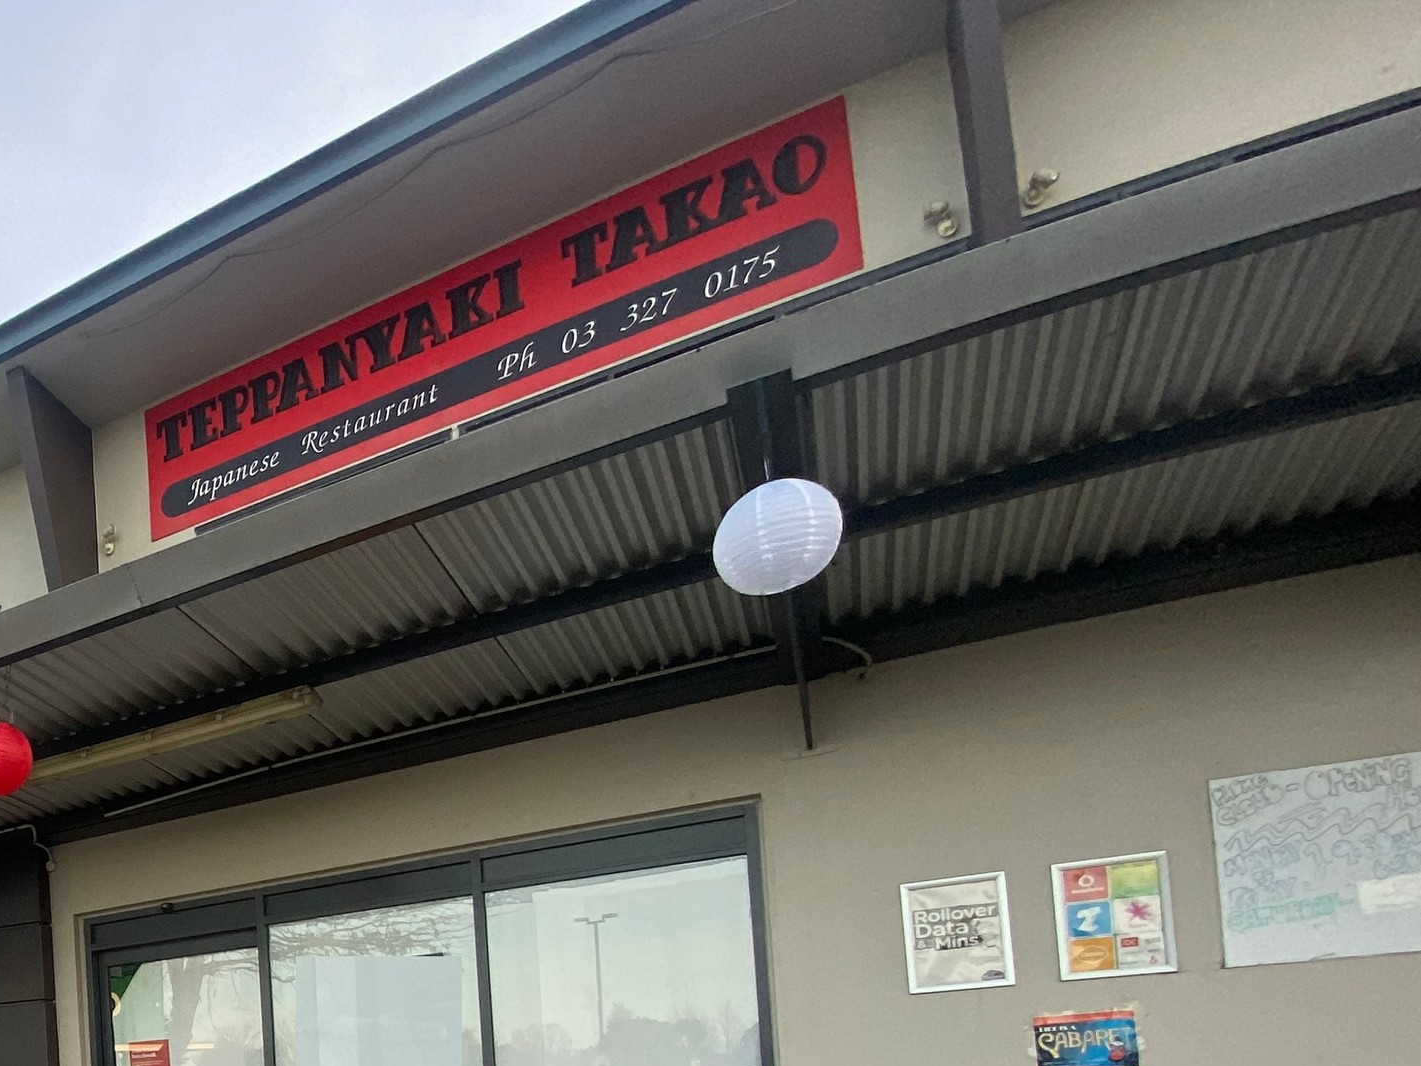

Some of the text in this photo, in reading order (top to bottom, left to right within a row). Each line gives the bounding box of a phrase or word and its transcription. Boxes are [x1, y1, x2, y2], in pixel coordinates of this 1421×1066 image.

[156, 134, 827, 463] TEPPANYAKI TAKAO
[187, 245, 780, 505] Japanese Restaurant Ph 03 327 0175
[913, 904, 996, 924] Rollover
[914, 921, 969, 939] Data
[934, 935, 980, 950] Mins
[1038, 1027, 1137, 1058] CABARET
